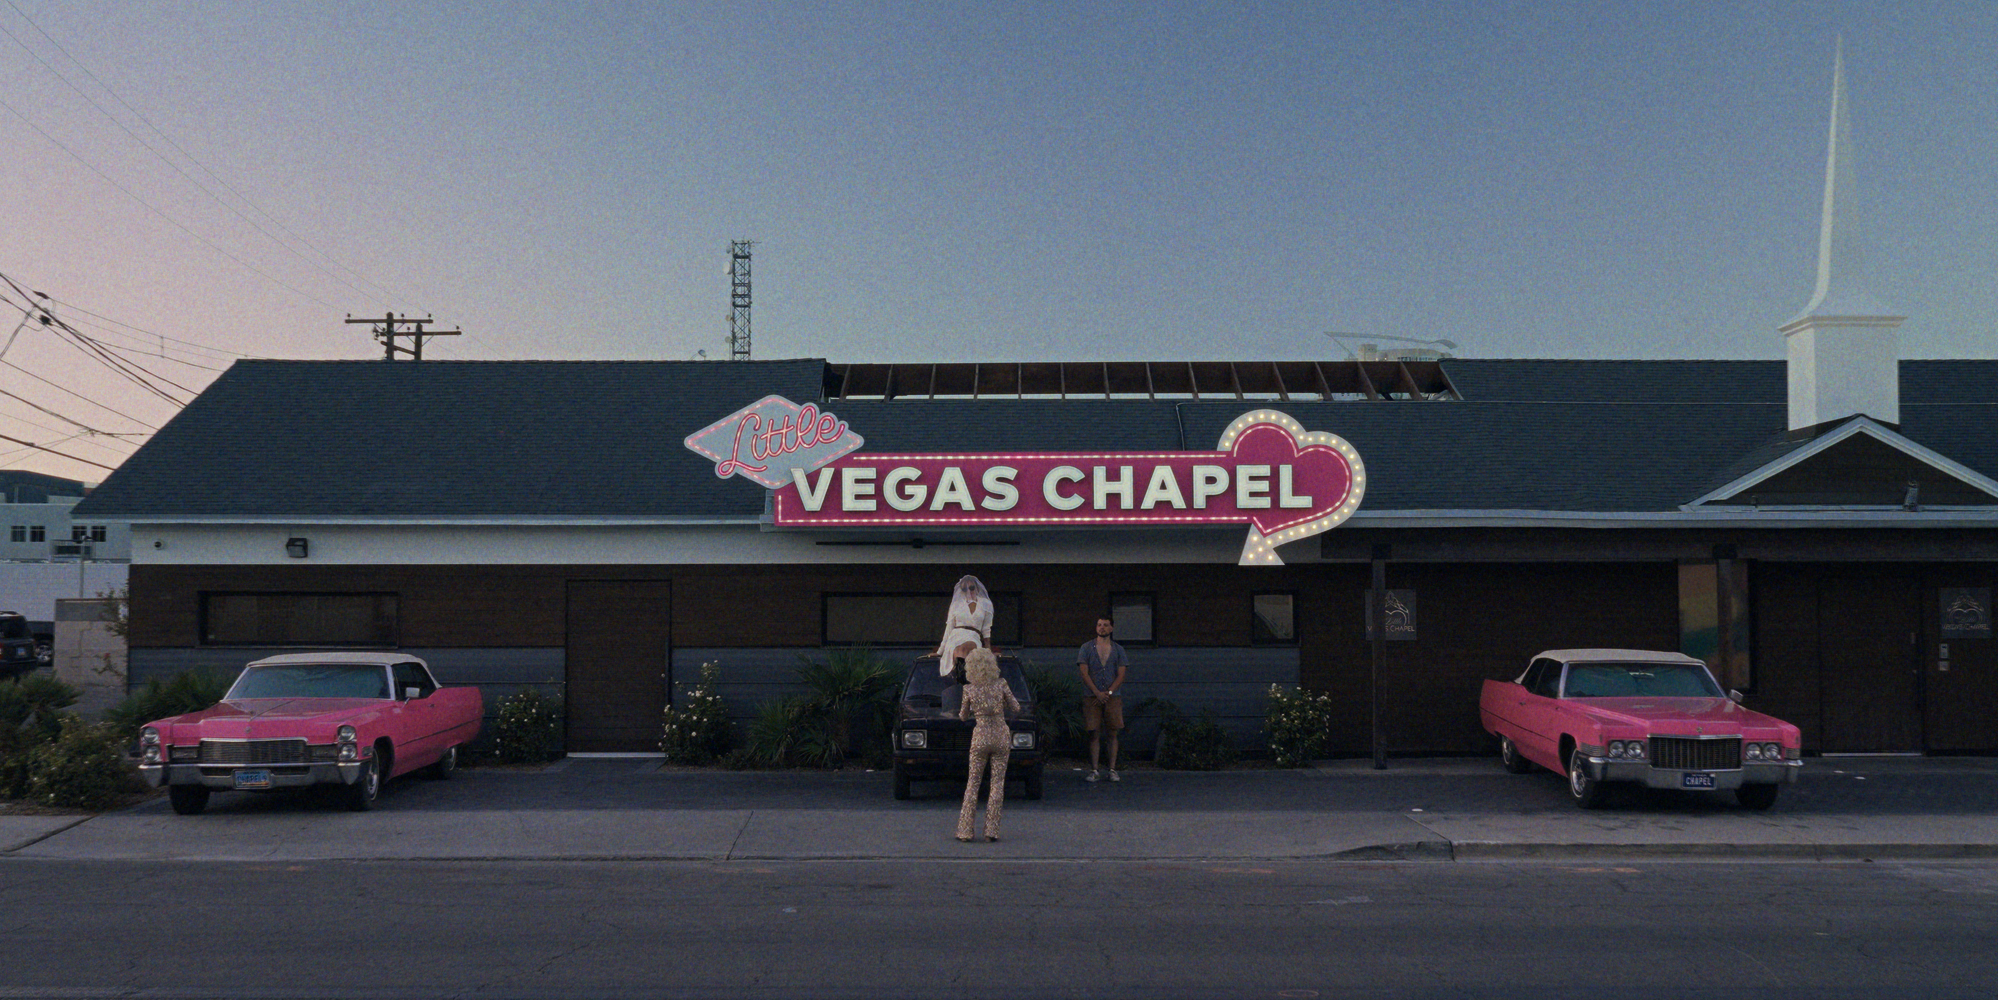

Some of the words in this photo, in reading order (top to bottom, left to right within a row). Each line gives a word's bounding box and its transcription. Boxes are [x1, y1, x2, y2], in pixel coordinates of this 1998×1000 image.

[717, 405, 845, 476] Little
[790, 466, 1020, 512] VEGAS
[1042, 464, 1313, 511] CHAPEL
[1685, 776, 1712, 786] CHAPEL
